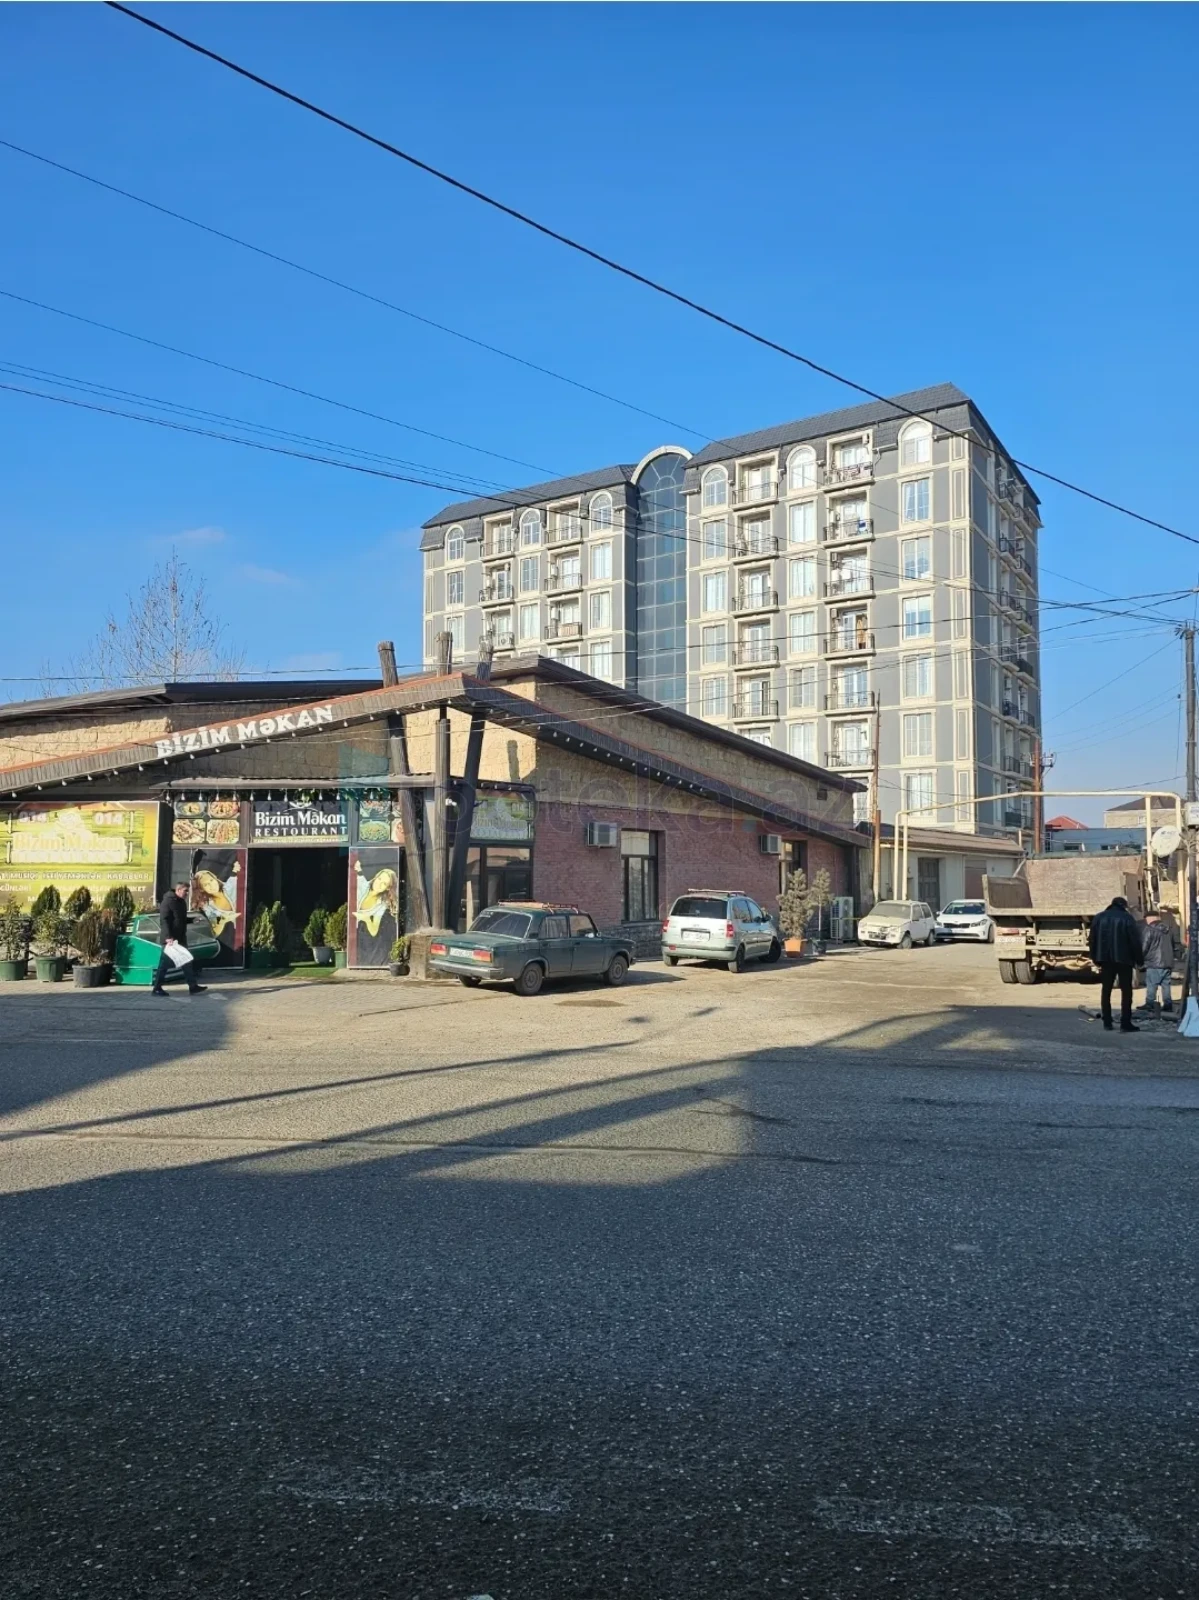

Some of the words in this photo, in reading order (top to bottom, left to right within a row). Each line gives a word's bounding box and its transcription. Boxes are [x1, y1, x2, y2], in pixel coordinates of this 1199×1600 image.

[155, 726, 230, 758] BİZİM
[238, 705, 333, 741] MƏKAN
[94, 812, 123, 825] 014
[255, 811, 295, 827] Bizim
[255, 827, 348, 837] RESTOURANT
